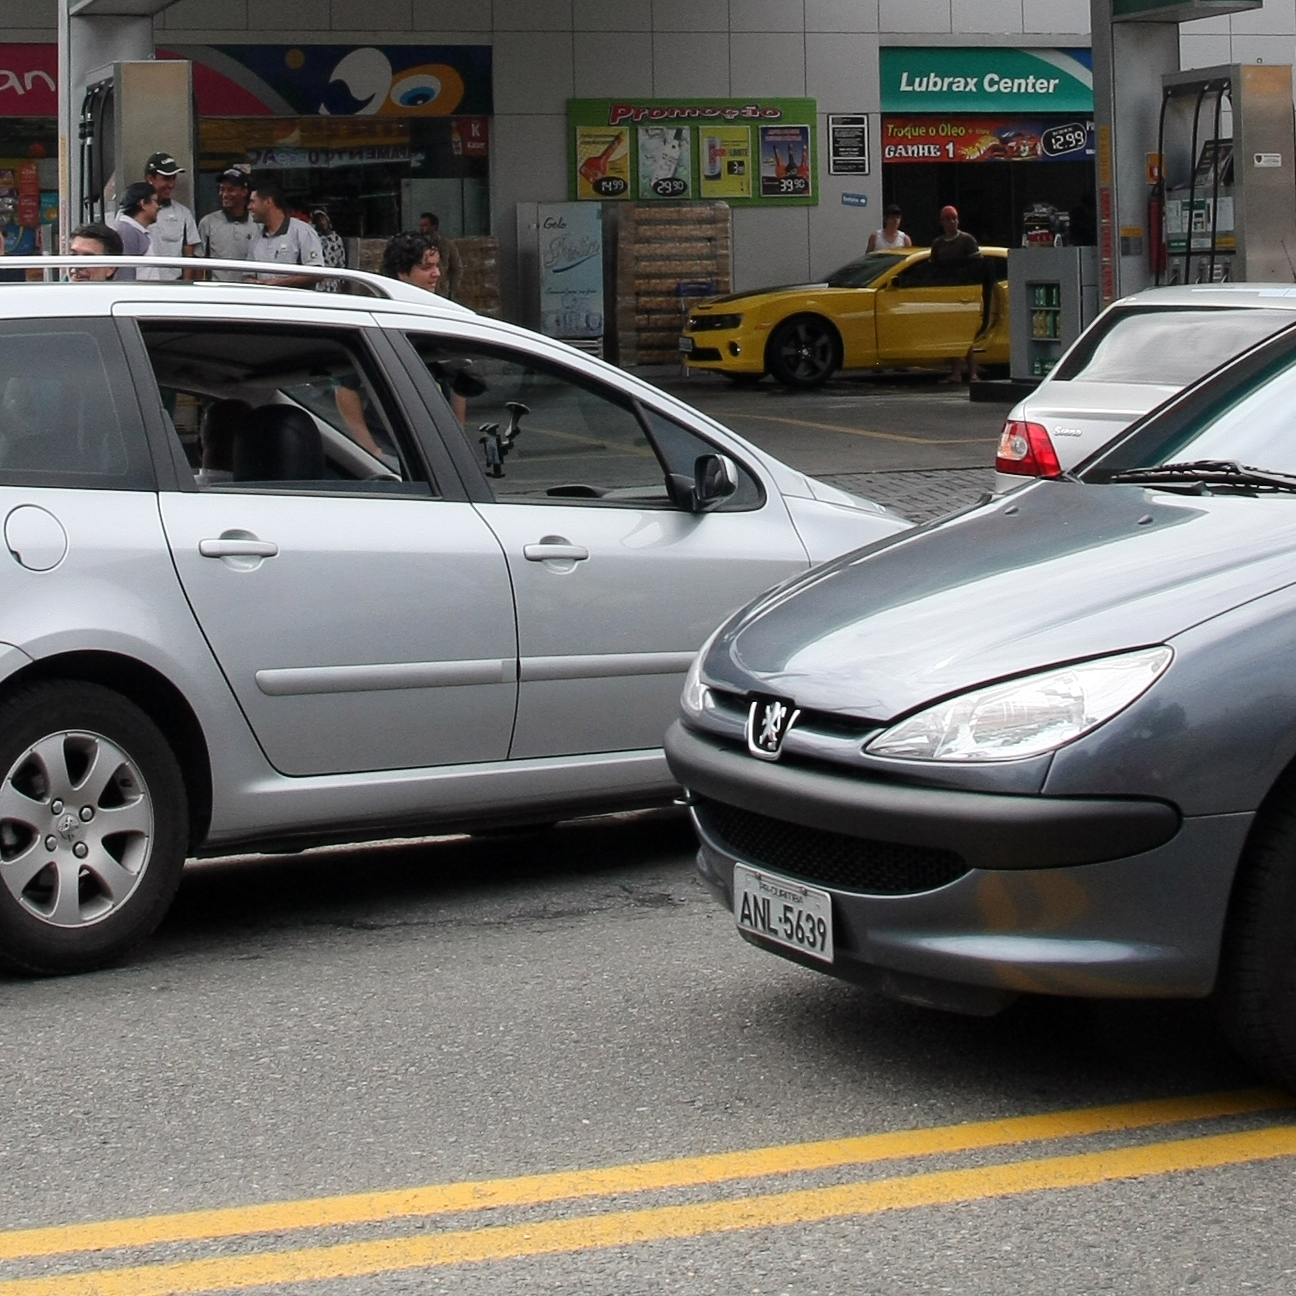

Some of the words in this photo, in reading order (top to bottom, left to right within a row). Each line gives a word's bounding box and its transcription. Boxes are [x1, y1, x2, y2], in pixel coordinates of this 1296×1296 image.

[900, 72, 979, 93] Lubrax
[983, 73, 1059, 94] Center
[608, 102, 782, 126] Promoção
[887, 124, 926, 140] Troque
[928, 127, 936, 136] o
[939, 122, 966, 137] Óleo
[945, 142, 954, 158] 1
[544, 217, 566, 229] Gelo
